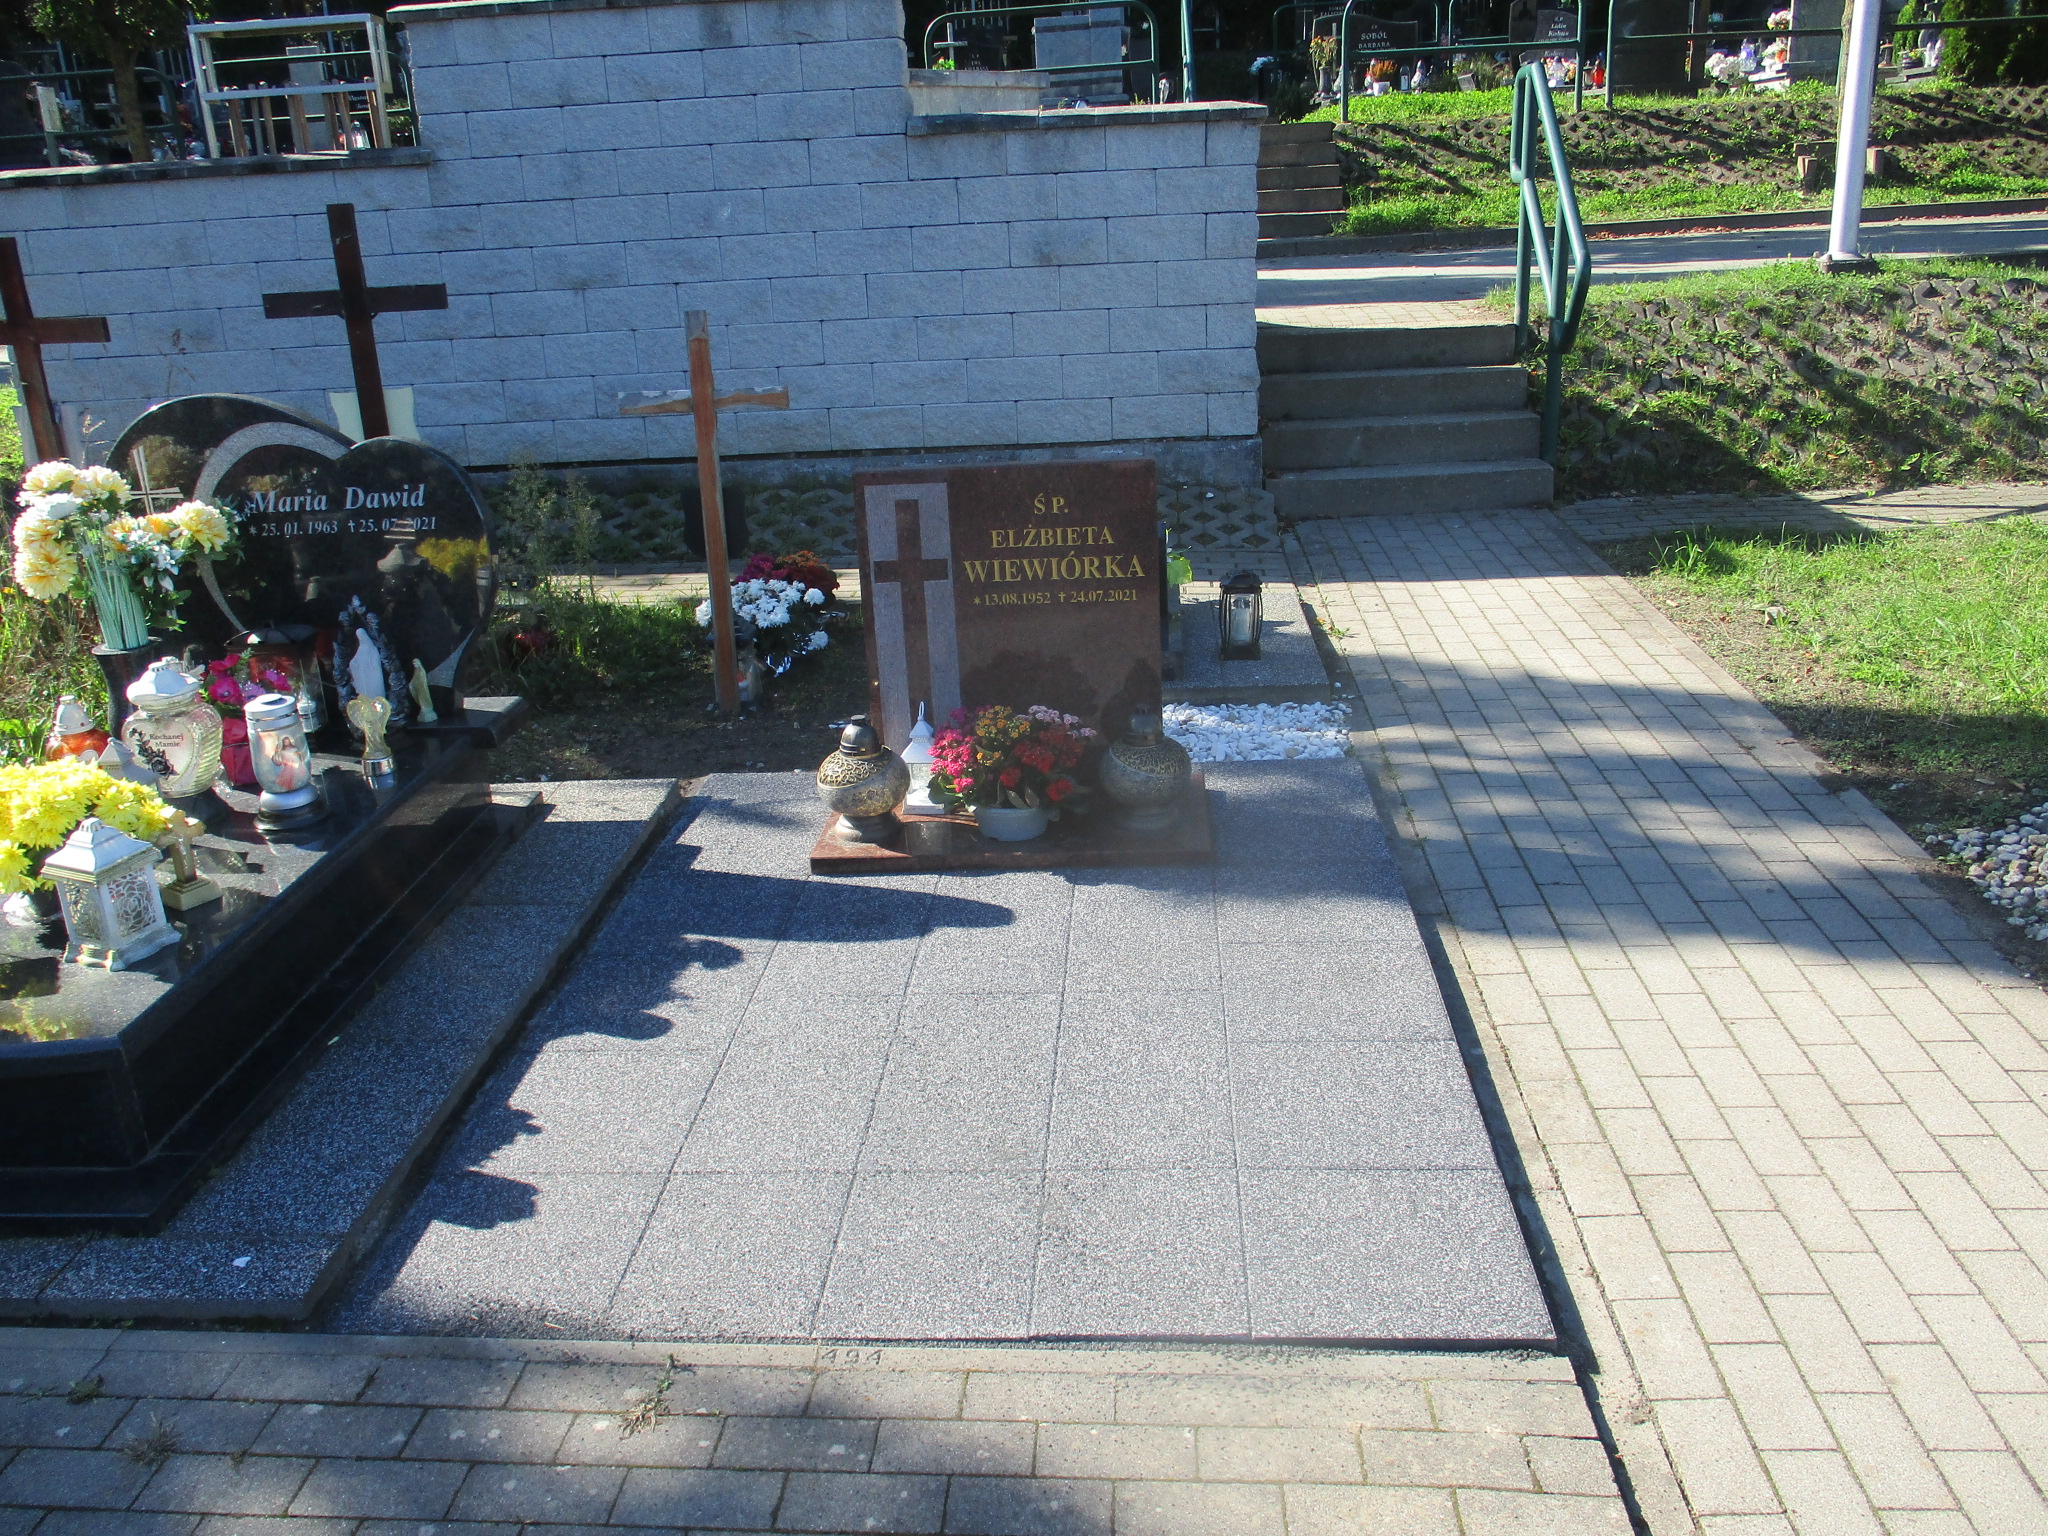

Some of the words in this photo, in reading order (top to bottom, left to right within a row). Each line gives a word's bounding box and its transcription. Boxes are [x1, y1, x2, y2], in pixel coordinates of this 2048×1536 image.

[250, 489, 329, 513] Maria
[343, 484, 426, 510] Dawid
[990, 524, 1115, 549] ELŻBIETA
[963, 550, 1146, 583] WIEWIÓRKA
[984, 592, 1051, 606] 13.08.1952
[1070, 589, 1138, 603] 24.07.2021
